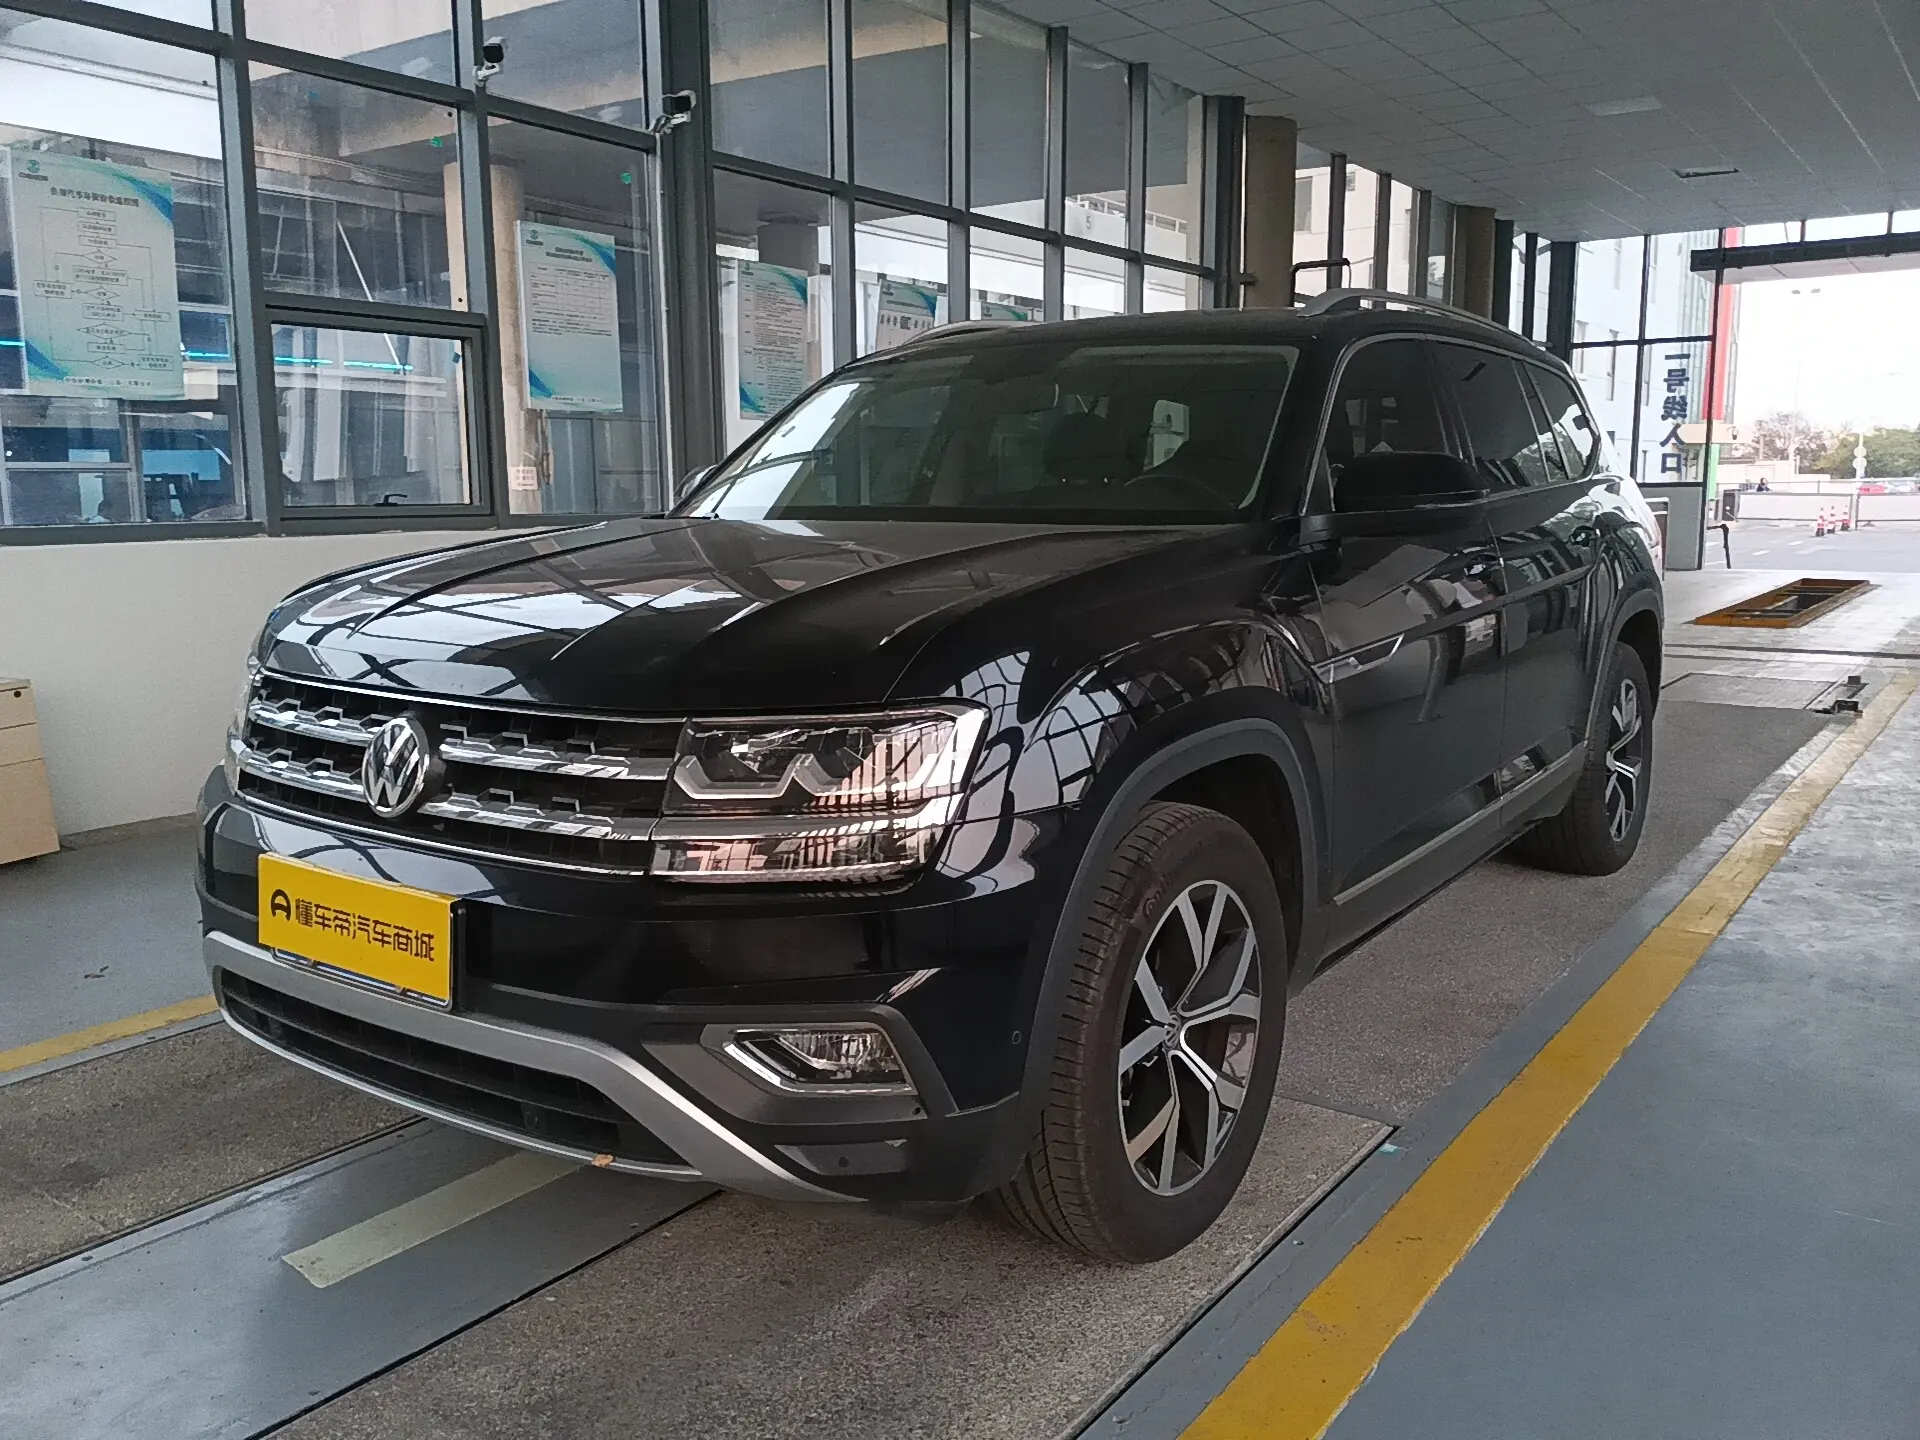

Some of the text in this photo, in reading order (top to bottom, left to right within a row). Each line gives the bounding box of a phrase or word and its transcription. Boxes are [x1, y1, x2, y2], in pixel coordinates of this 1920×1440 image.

[295, 897, 435, 962] 懂车帝汽车商城
